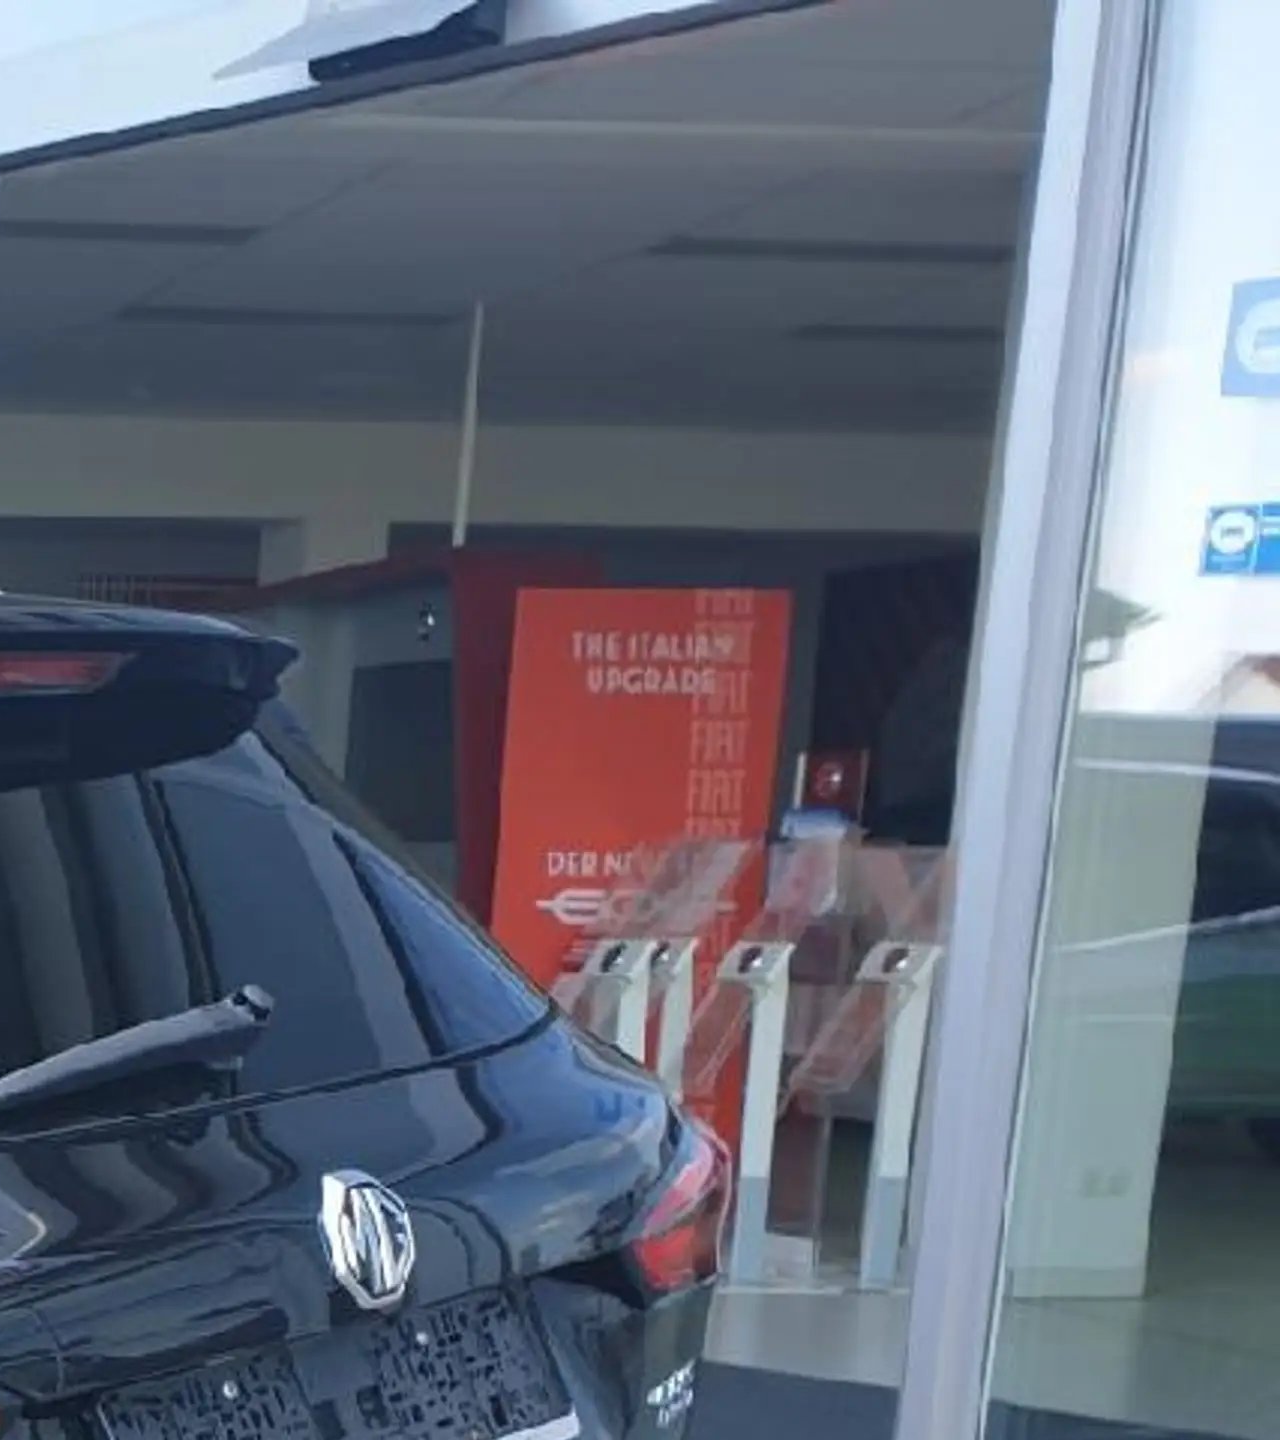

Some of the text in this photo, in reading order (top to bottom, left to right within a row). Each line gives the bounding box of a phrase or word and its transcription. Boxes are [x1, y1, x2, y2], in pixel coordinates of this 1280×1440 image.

[571, 631, 734, 664] THE ITALIAN
[586, 666, 717, 695] UPGRADE
[547, 851, 598, 877] DER
